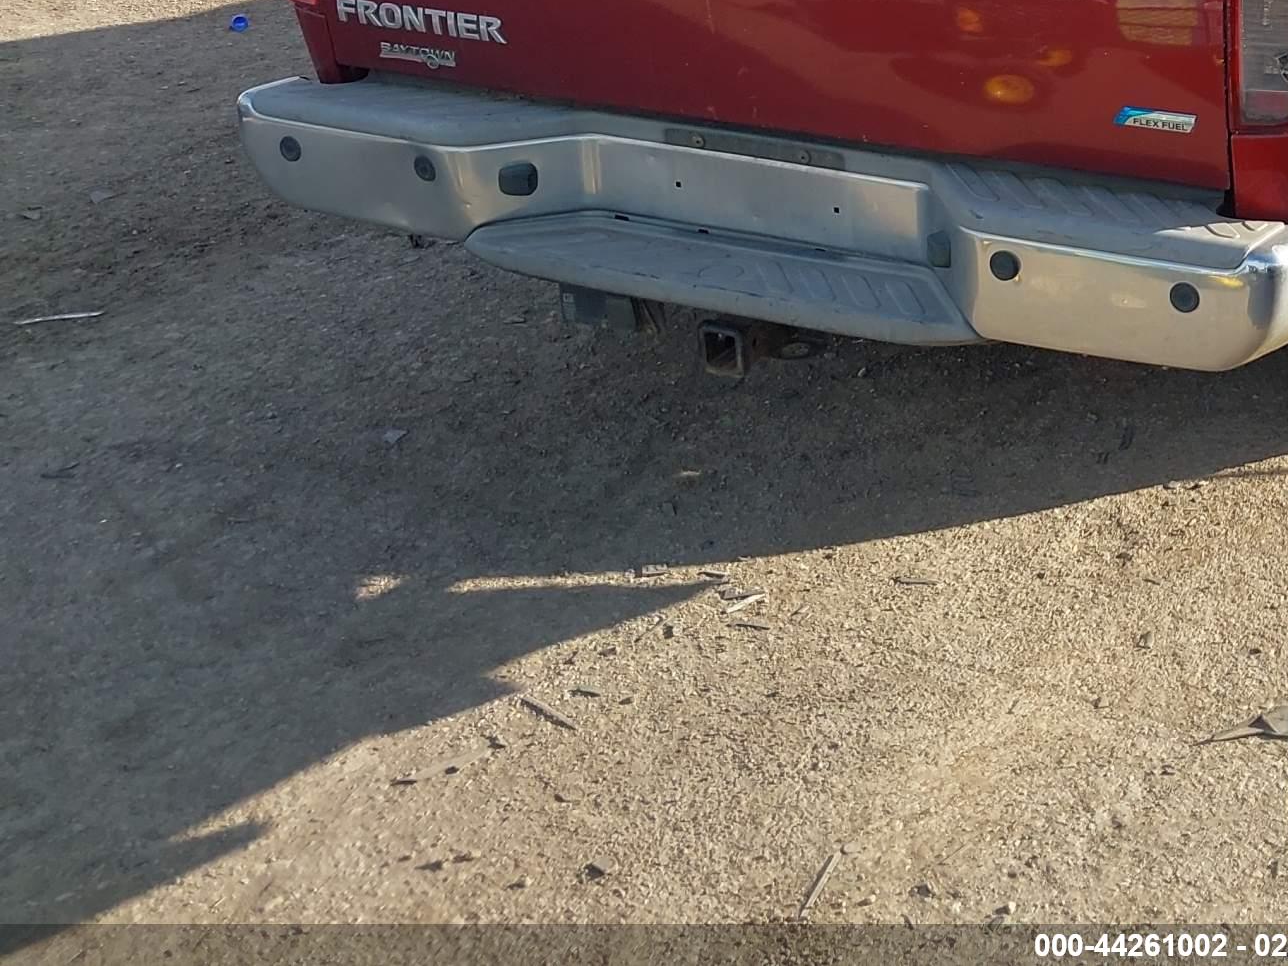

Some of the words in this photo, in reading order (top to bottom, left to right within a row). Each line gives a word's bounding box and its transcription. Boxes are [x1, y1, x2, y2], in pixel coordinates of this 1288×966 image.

[380, 41, 456, 62] BAYTOWN
[1132, 117, 1160, 128] FLEX
[1161, 121, 1189, 132] FUEL
